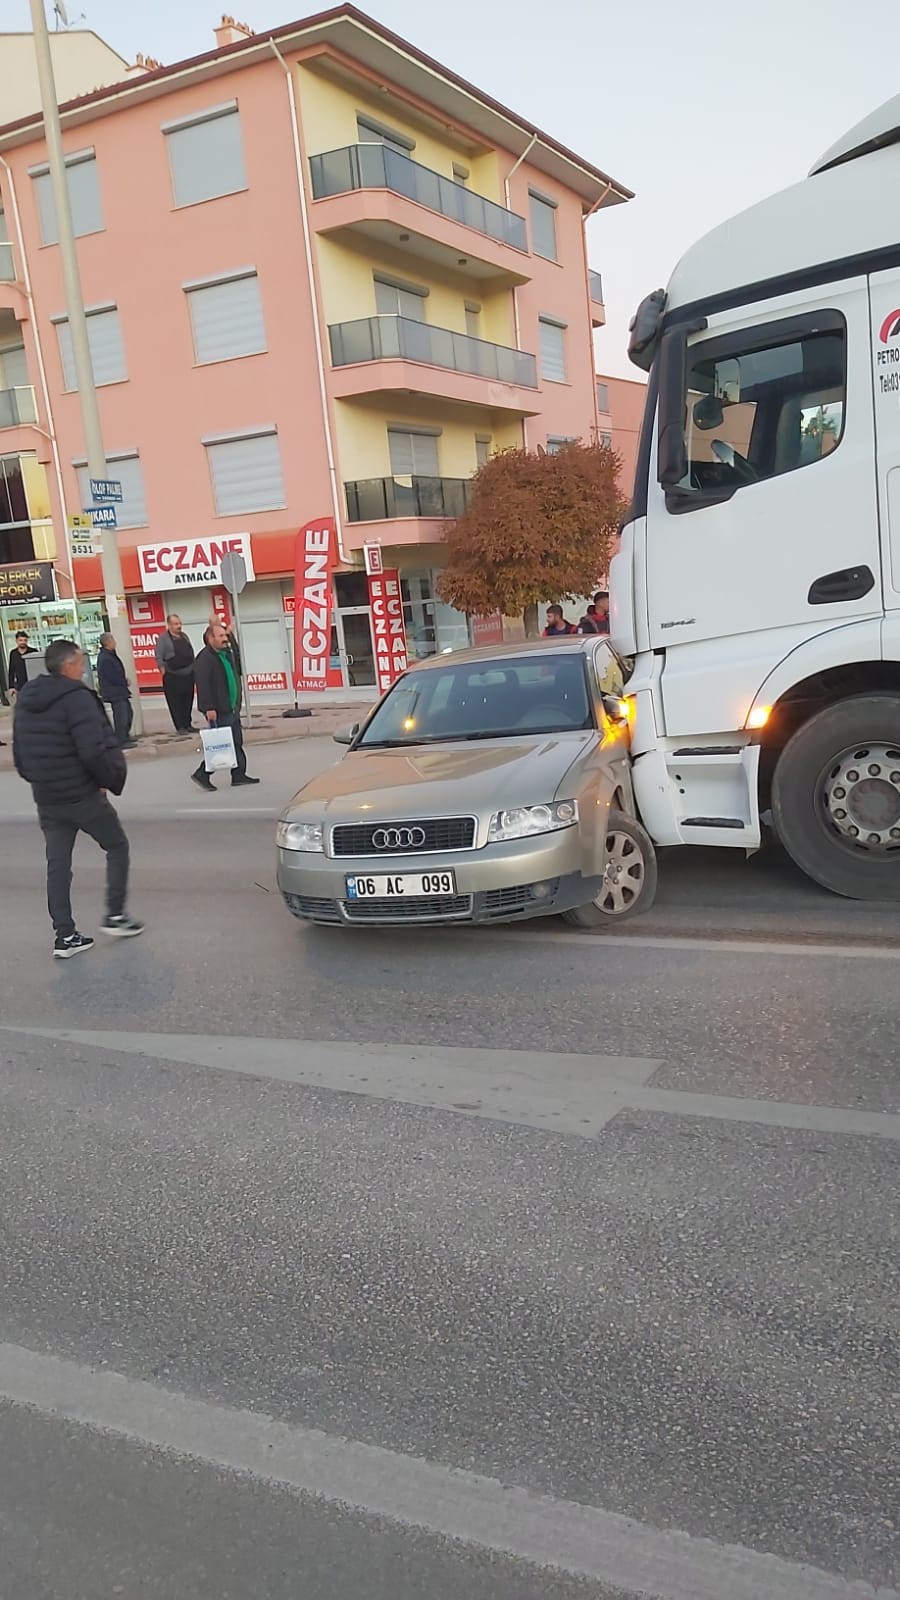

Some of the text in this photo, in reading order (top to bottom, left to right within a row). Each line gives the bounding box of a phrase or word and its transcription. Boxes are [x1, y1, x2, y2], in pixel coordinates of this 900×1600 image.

[877, 348, 900, 365] PETRO
[72, 545, 93, 554] 9531
[9, 569, 42, 581] ERKEK
[174, 571, 217, 584] ATMACA
[303, 530, 329, 678] ECZANE
[385, 580, 408, 673] ECZAN
[130, 633, 160, 648] TMAC
[371, 581, 391, 690] ECZANE
[131, 648, 156, 658] CZAN
[247, 673, 283, 683] ATMACA
[357, 874, 451, 895] 06 AC 099
